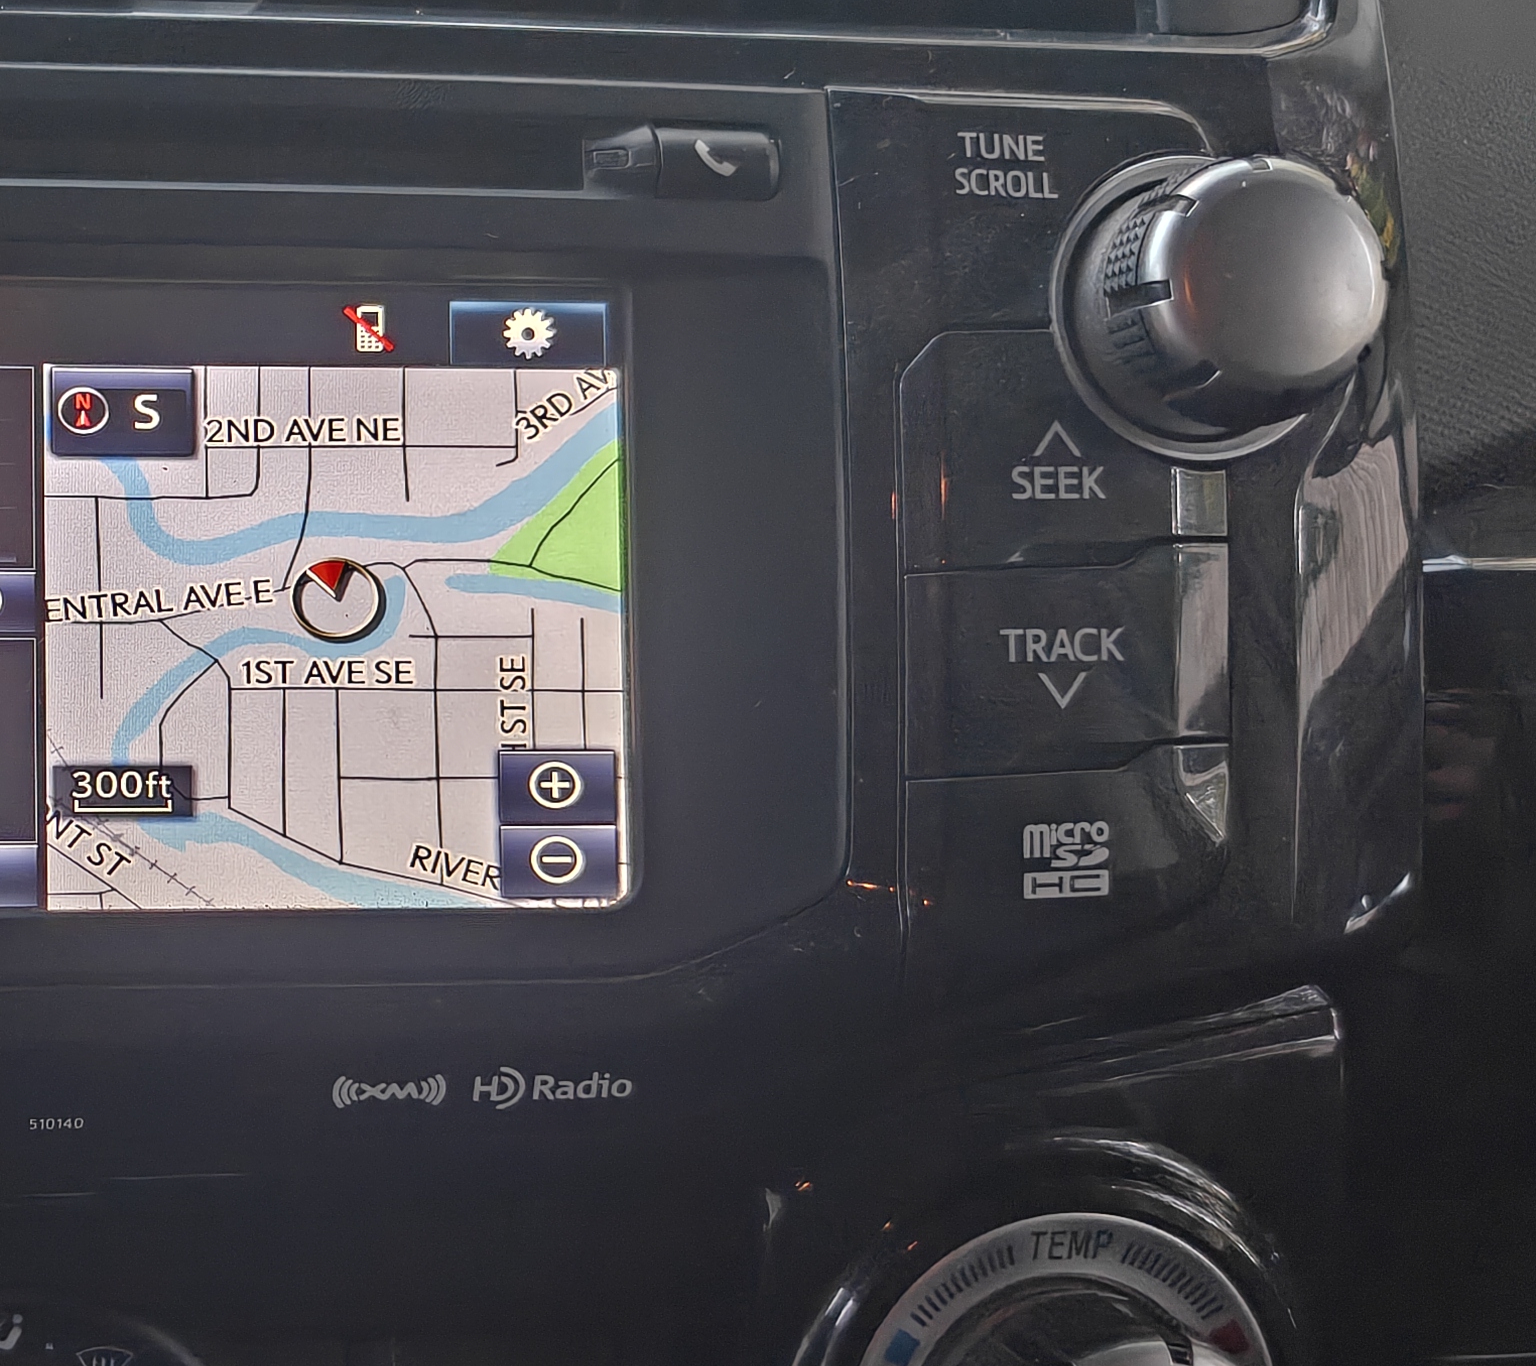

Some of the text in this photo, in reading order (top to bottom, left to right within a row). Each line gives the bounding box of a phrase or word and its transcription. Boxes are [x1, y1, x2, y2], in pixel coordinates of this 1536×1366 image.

[957, 132, 1045, 163] TUNE
[954, 166, 1059, 200] SCROLL
[75, 392, 92, 410] N
[133, 393, 161, 430] S
[514, 392, 573, 441] 3RD
[206, 417, 402, 444] 2ND AVE NE
[1011, 465, 1107, 501] SEEK
[183, 581, 245, 611] AVE
[253, 578, 273, 605] E
[1000, 627, 1124, 663] TRACK
[242, 660, 415, 685] 1ST AVE SE
[499, 655, 527, 691] SE
[499, 698, 527, 734] ST
[71, 770, 172, 799] 300ft
[1023, 820, 1110, 859] micro
[86, 841, 132, 877] ST
[409, 844, 502, 891] RIVER
[472, 1066, 634, 1110] HD Radio
[28, 1117, 85, 1131] 510140
[1029, 1229, 1114, 1262] TEMP
